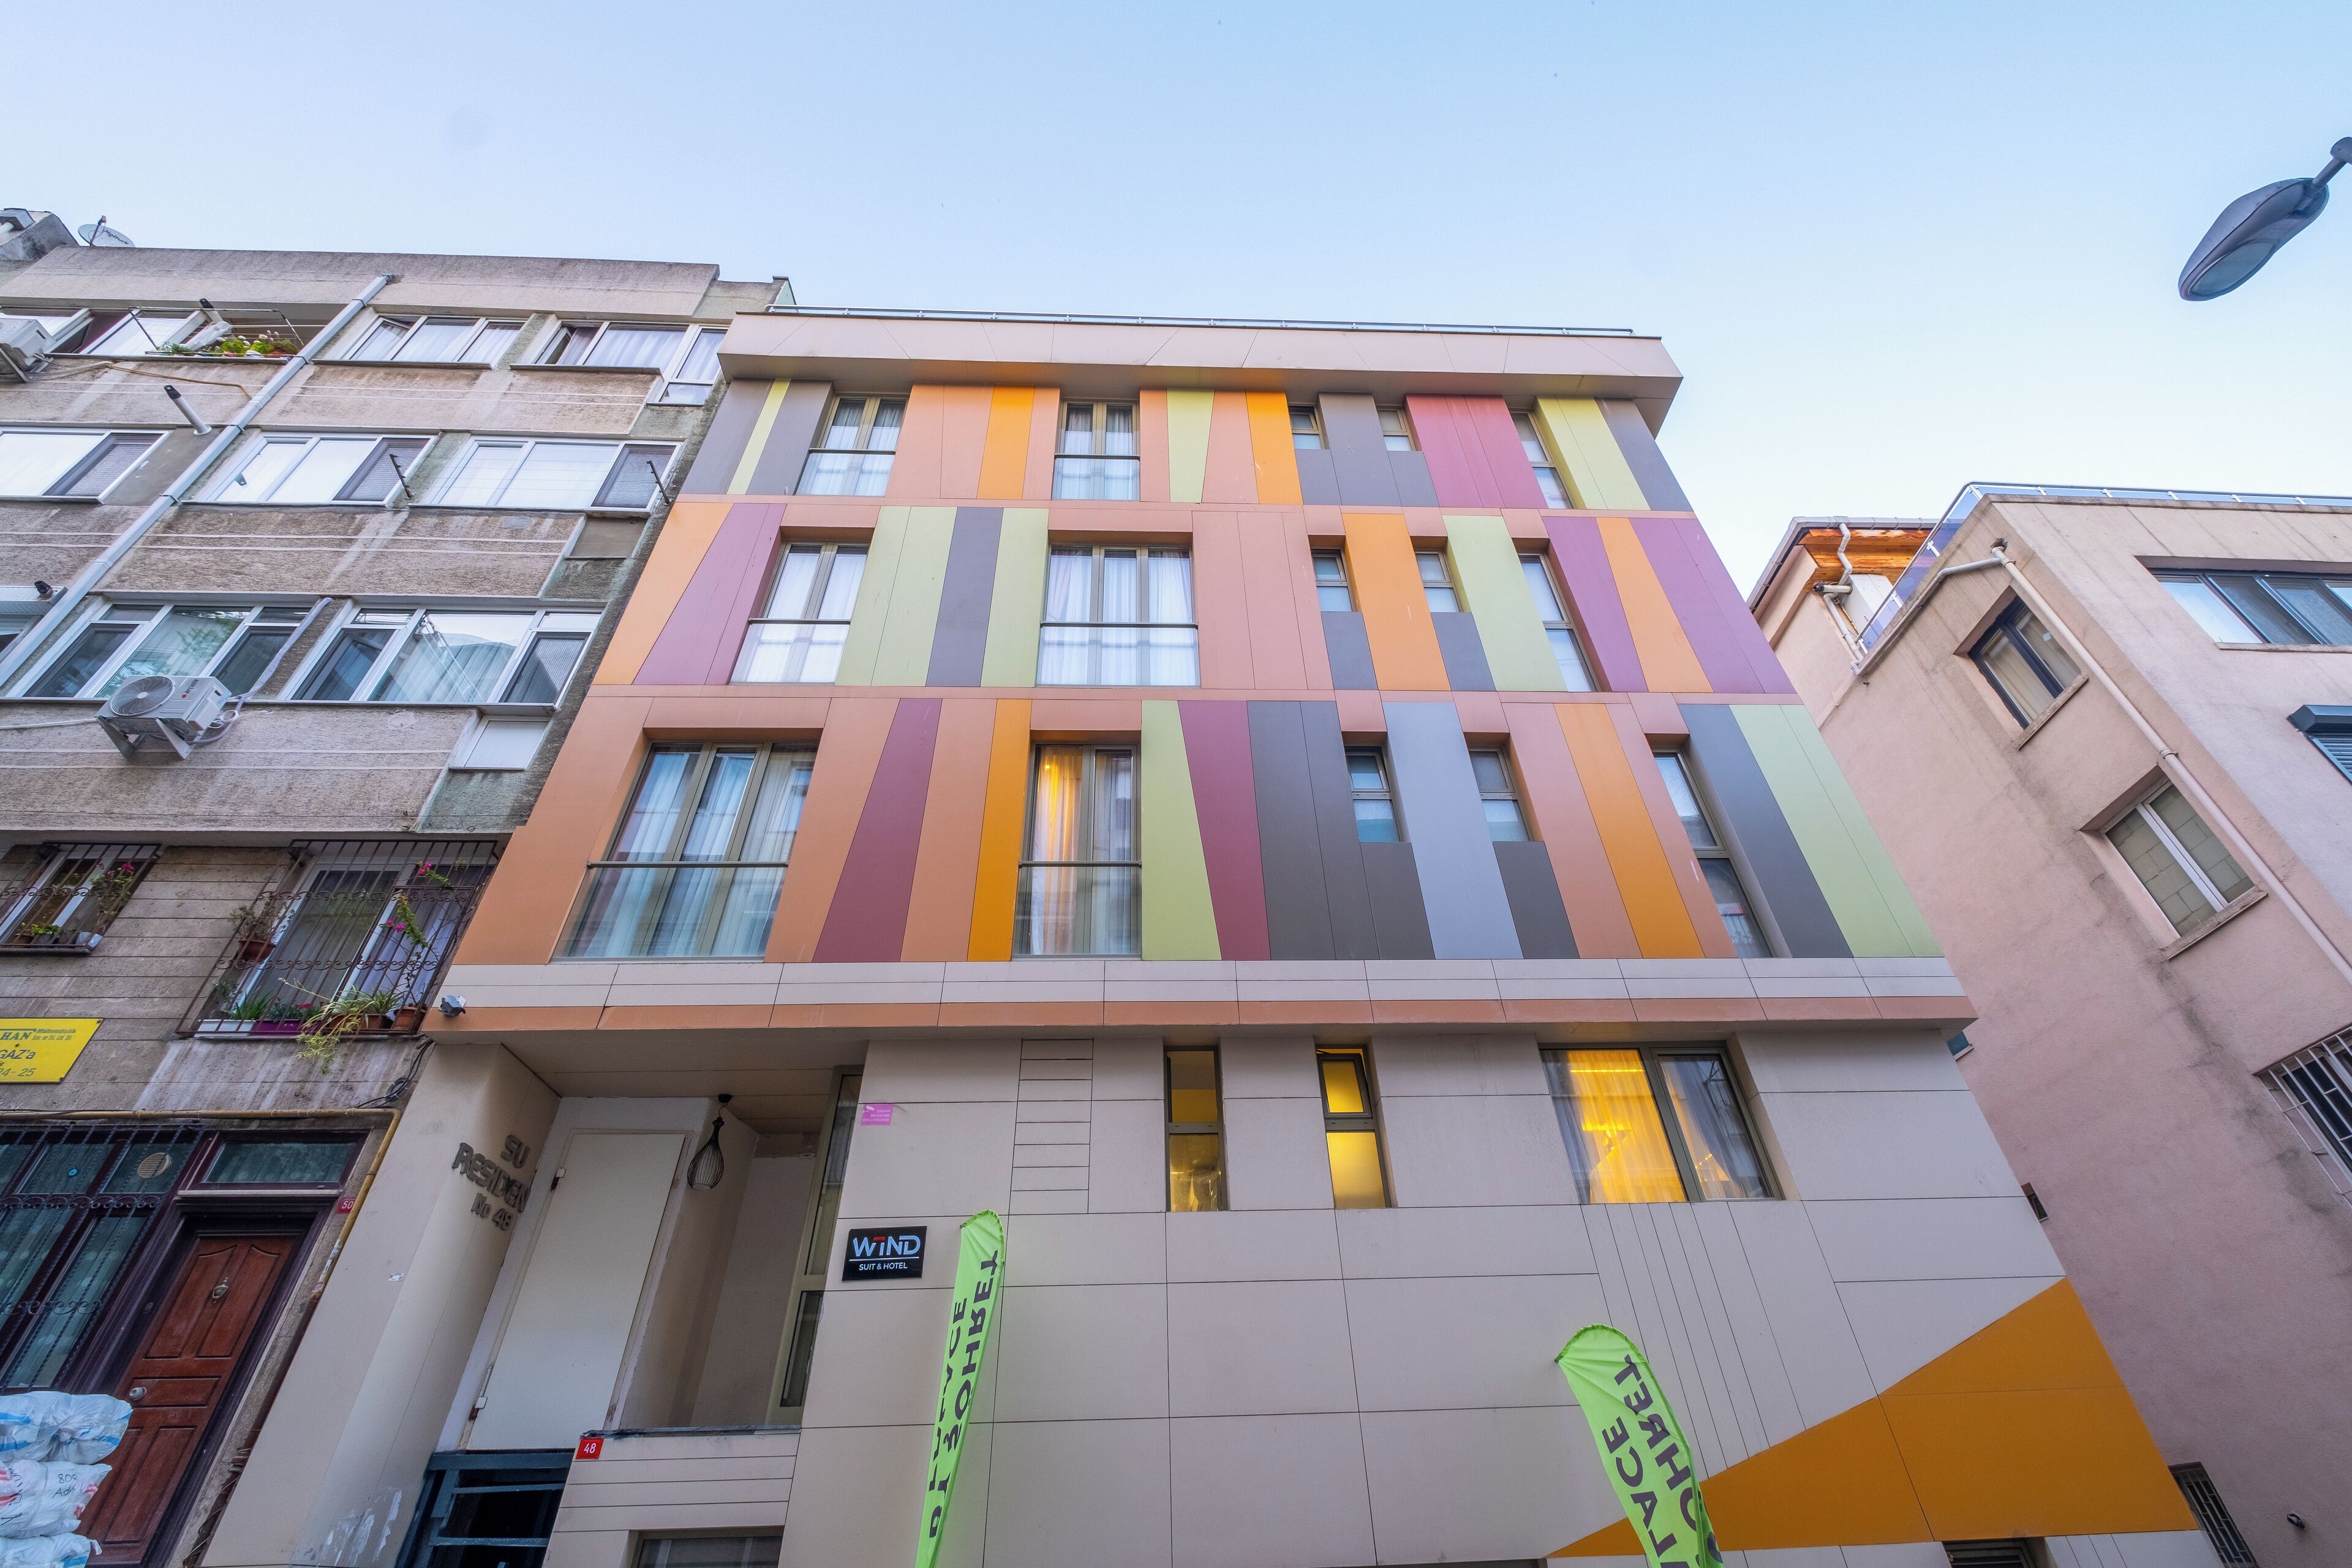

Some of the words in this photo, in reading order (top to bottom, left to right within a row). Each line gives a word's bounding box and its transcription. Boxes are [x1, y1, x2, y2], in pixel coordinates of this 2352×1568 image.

[18, 1068, 36, 1077] 25
[500, 1134, 531, 1169] SU
[342, 1200, 354, 1209] 50
[470, 1193, 491, 1218] No
[491, 1208, 513, 1231] 48
[584, 1442, 597, 1453] 48
